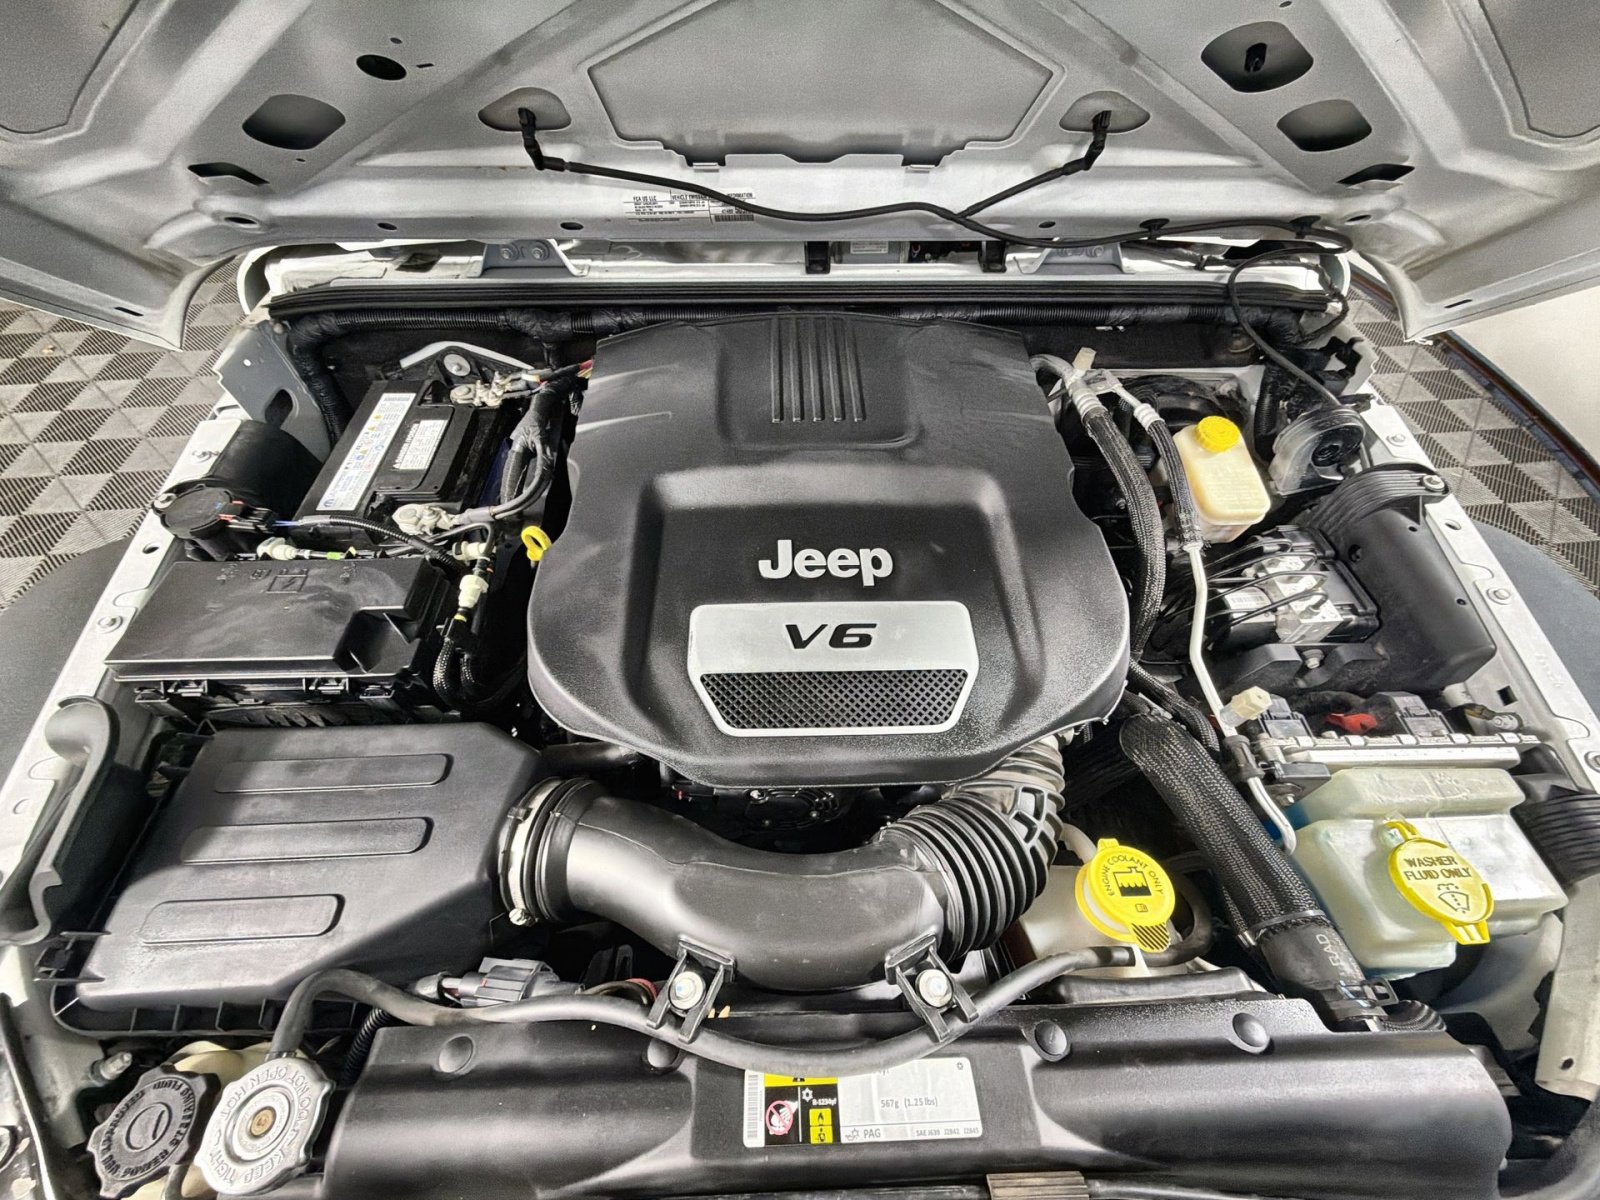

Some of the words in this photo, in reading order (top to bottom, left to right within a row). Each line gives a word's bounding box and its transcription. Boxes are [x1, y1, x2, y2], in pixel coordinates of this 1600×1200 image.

[757, 539, 893, 587] Jeep
[784, 623, 878, 650] V6
[1107, 854, 1148, 870] COOLANT
[1403, 856, 1458, 868] WASHER
[1404, 869, 1439, 881] FLUID
[1441, 867, 1472, 879] ONLY
[1101, 865, 1115, 897] ENGINE
[1148, 870, 1164, 895] ONLY
[289, 1071, 311, 1096] NOT
[221, 1084, 247, 1120] HOT
[880, 1099, 900, 1109] 567g
[903, 1098, 923, 1108] (1.25
[924, 1097, 939, 1107] lbs)
[863, 1128, 881, 1138] PAG
[916, 1129, 927, 1137] SAE
